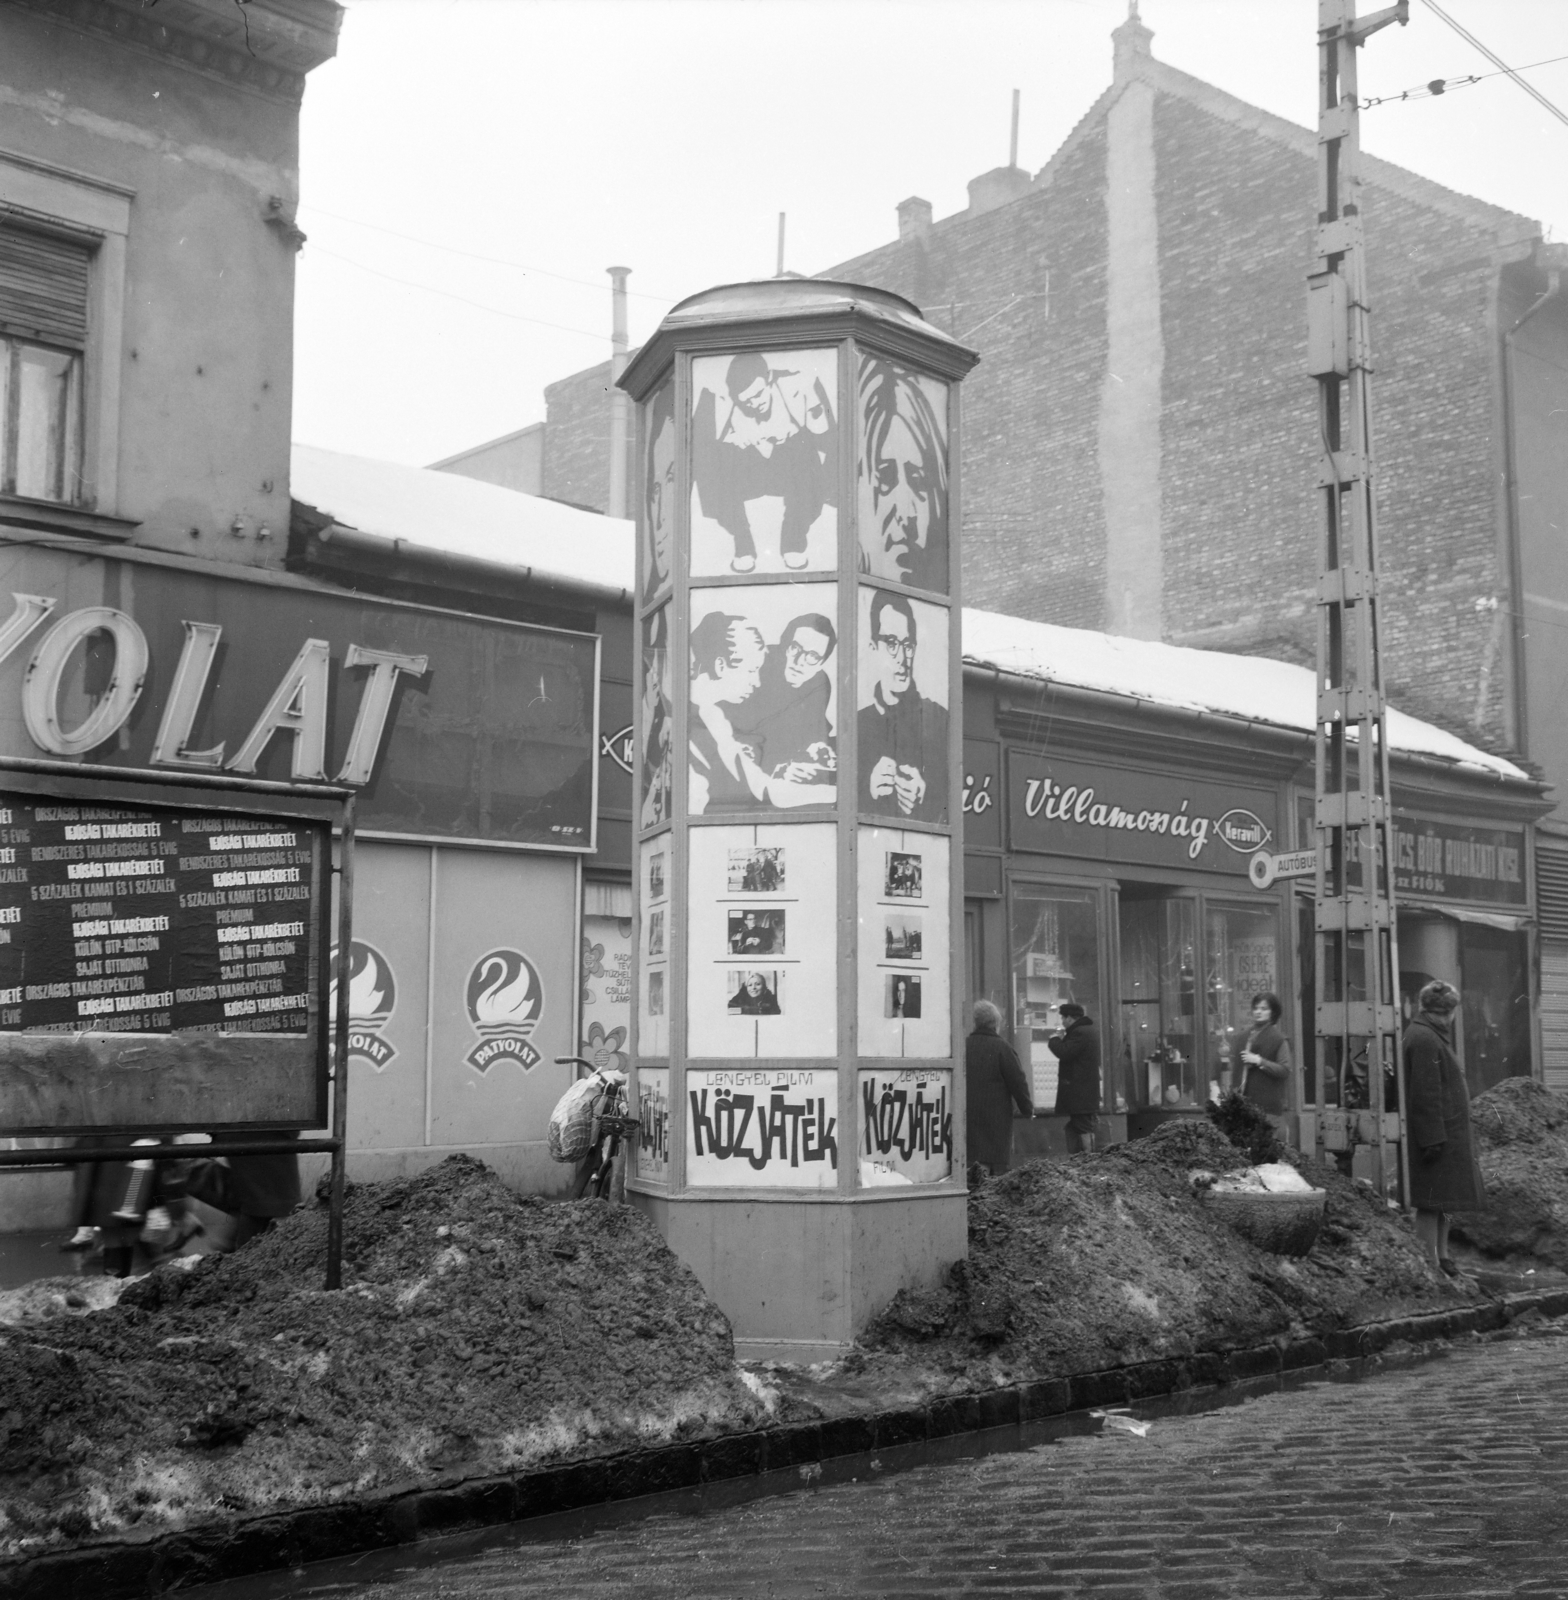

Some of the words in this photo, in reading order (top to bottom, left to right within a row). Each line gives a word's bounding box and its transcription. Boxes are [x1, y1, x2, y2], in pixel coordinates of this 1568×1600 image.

[1025, 778, 1208, 858] Villamosság
[102, 822, 161, 838] TAKARÉKBETÉT
[243, 832, 297, 848] TAKARÉKBETÉT
[31, 845, 85, 861] RENDSZERES
[86, 841, 149, 858] TAKARÉKOSSÁG
[151, 843, 157, 855] 5
[159, 841, 178, 855] ÉVIG
[179, 855, 228, 871] RENDSZERES
[229, 851, 286, 868] TAKARÉKOSSÁG
[288, 852, 294, 864] 5
[295, 850, 312, 863] ÉVIG
[104, 859, 164, 876] TAKARÉKBETÉT
[246, 867, 300, 884] TAKARÉKBETÉT
[31, 886, 37, 900] 5
[39, 883, 82, 899] SZÁZALÉK
[84, 882, 114, 897] KAMAT
[116, 881, 127, 895] ÉS
[135, 878, 176, 894] SZÁZALÉK
[1412, 874, 1446, 893] FIÓK
[179, 894, 186, 908] 5
[187, 891, 226, 907] SZÁZALÉK
[228, 889, 256, 904] KAMAT
[257, 889, 267, 902] ÉS
[274, 885, 310, 900] SZÁZALÉK
[71, 901, 113, 918] PRÉMIUM
[216, 908, 254, 924] PRÉMIUM
[110, 916, 169, 934] TAKARÉKBETÉT
[250, 921, 304, 939] TAKARÉKBETÉT
[76, 959, 102, 976] SAJÁT
[105, 957, 149, 974] OTTHONRA
[220, 964, 245, 980] SAJÁT
[246, 960, 286, 977] OTTHONRA
[25, 983, 71, 1000] ORSZÁGOS
[72, 976, 145, 996] TAKARÉKPÉNZTÁR
[176, 986, 217, 1003] ORSZÁGOS
[217, 978, 283, 999] TAKARÉKPÉNZTÁR
[115, 991, 174, 1011] TAKARÉKBETÉT
[143, 1014, 150, 1028] 5
[152, 1012, 171, 1027] ÉVIG
[282, 1015, 288, 1028] 5
[290, 1013, 307, 1027] ÉVIG
[474, 1038, 536, 1066] PATYOLAT
[706, 1072, 771, 1086] LENGYEL
[690, 1085, 838, 1170] KÖZJÁTÉK
